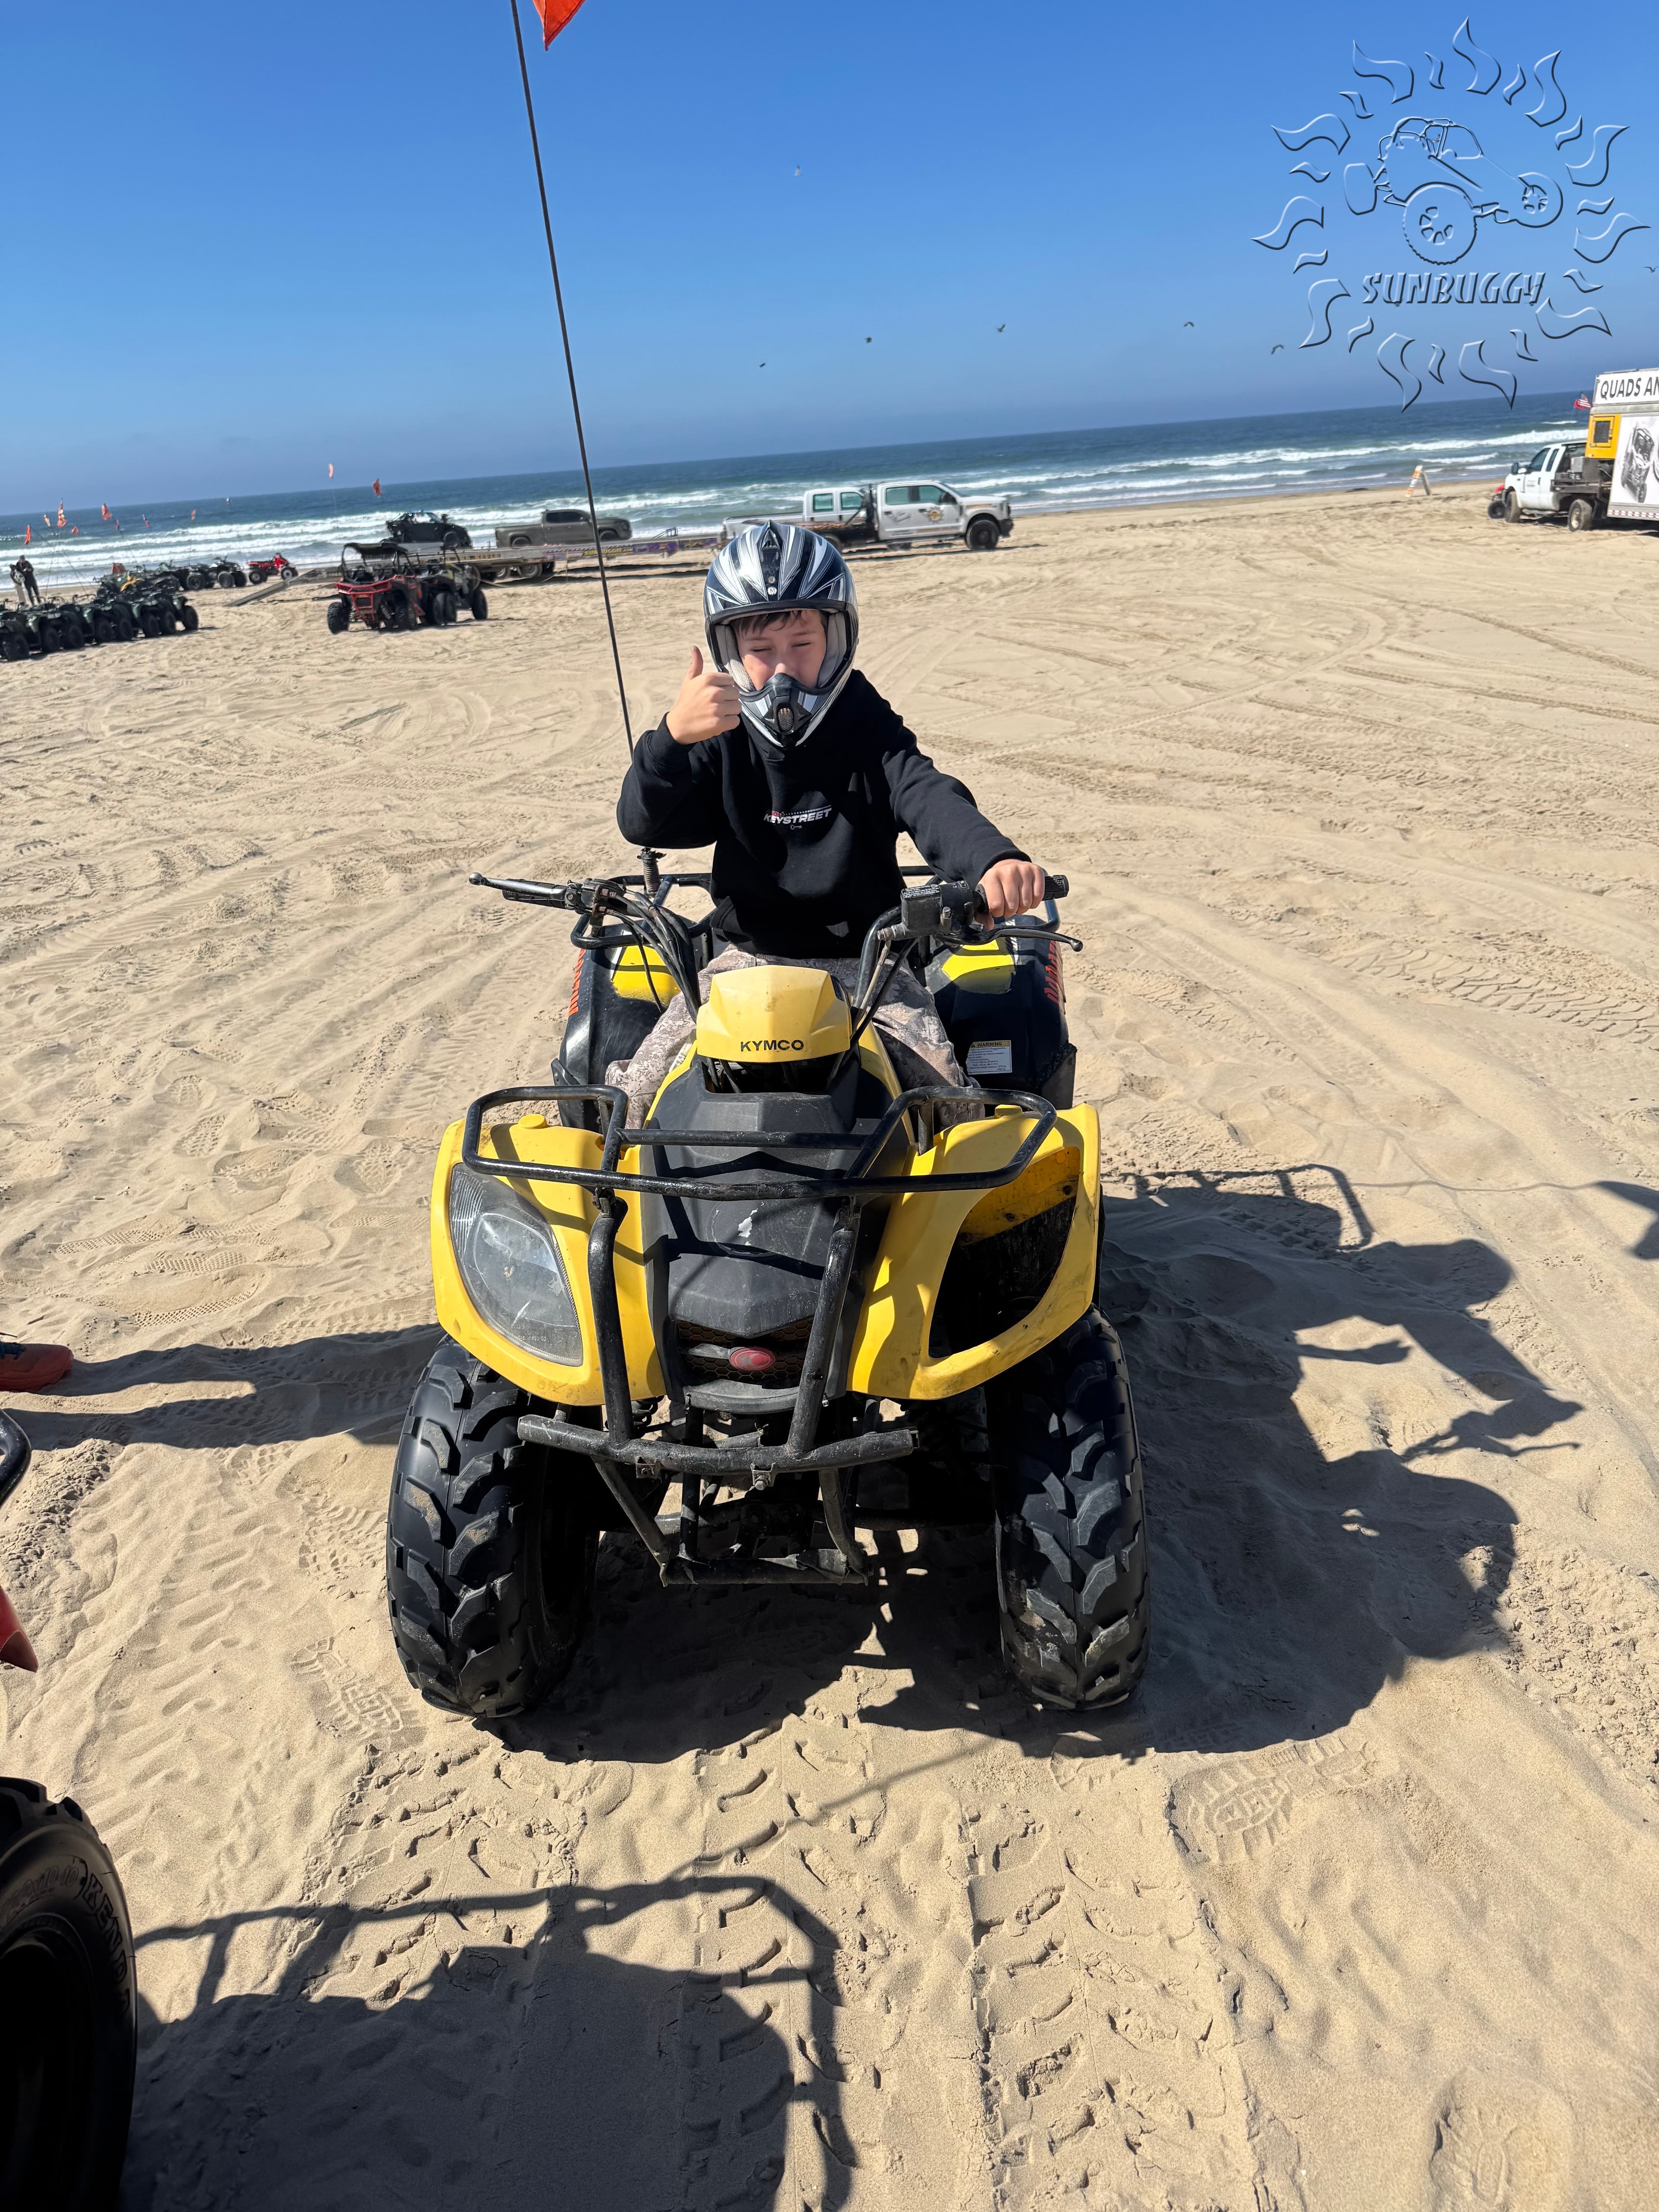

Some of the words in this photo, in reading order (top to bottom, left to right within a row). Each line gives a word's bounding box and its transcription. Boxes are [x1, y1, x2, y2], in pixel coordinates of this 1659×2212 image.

[1600, 377, 1642, 400] QUADS
[763, 807, 832, 824] KEYSTREET
[741, 1039, 804, 1052] KYMCO
